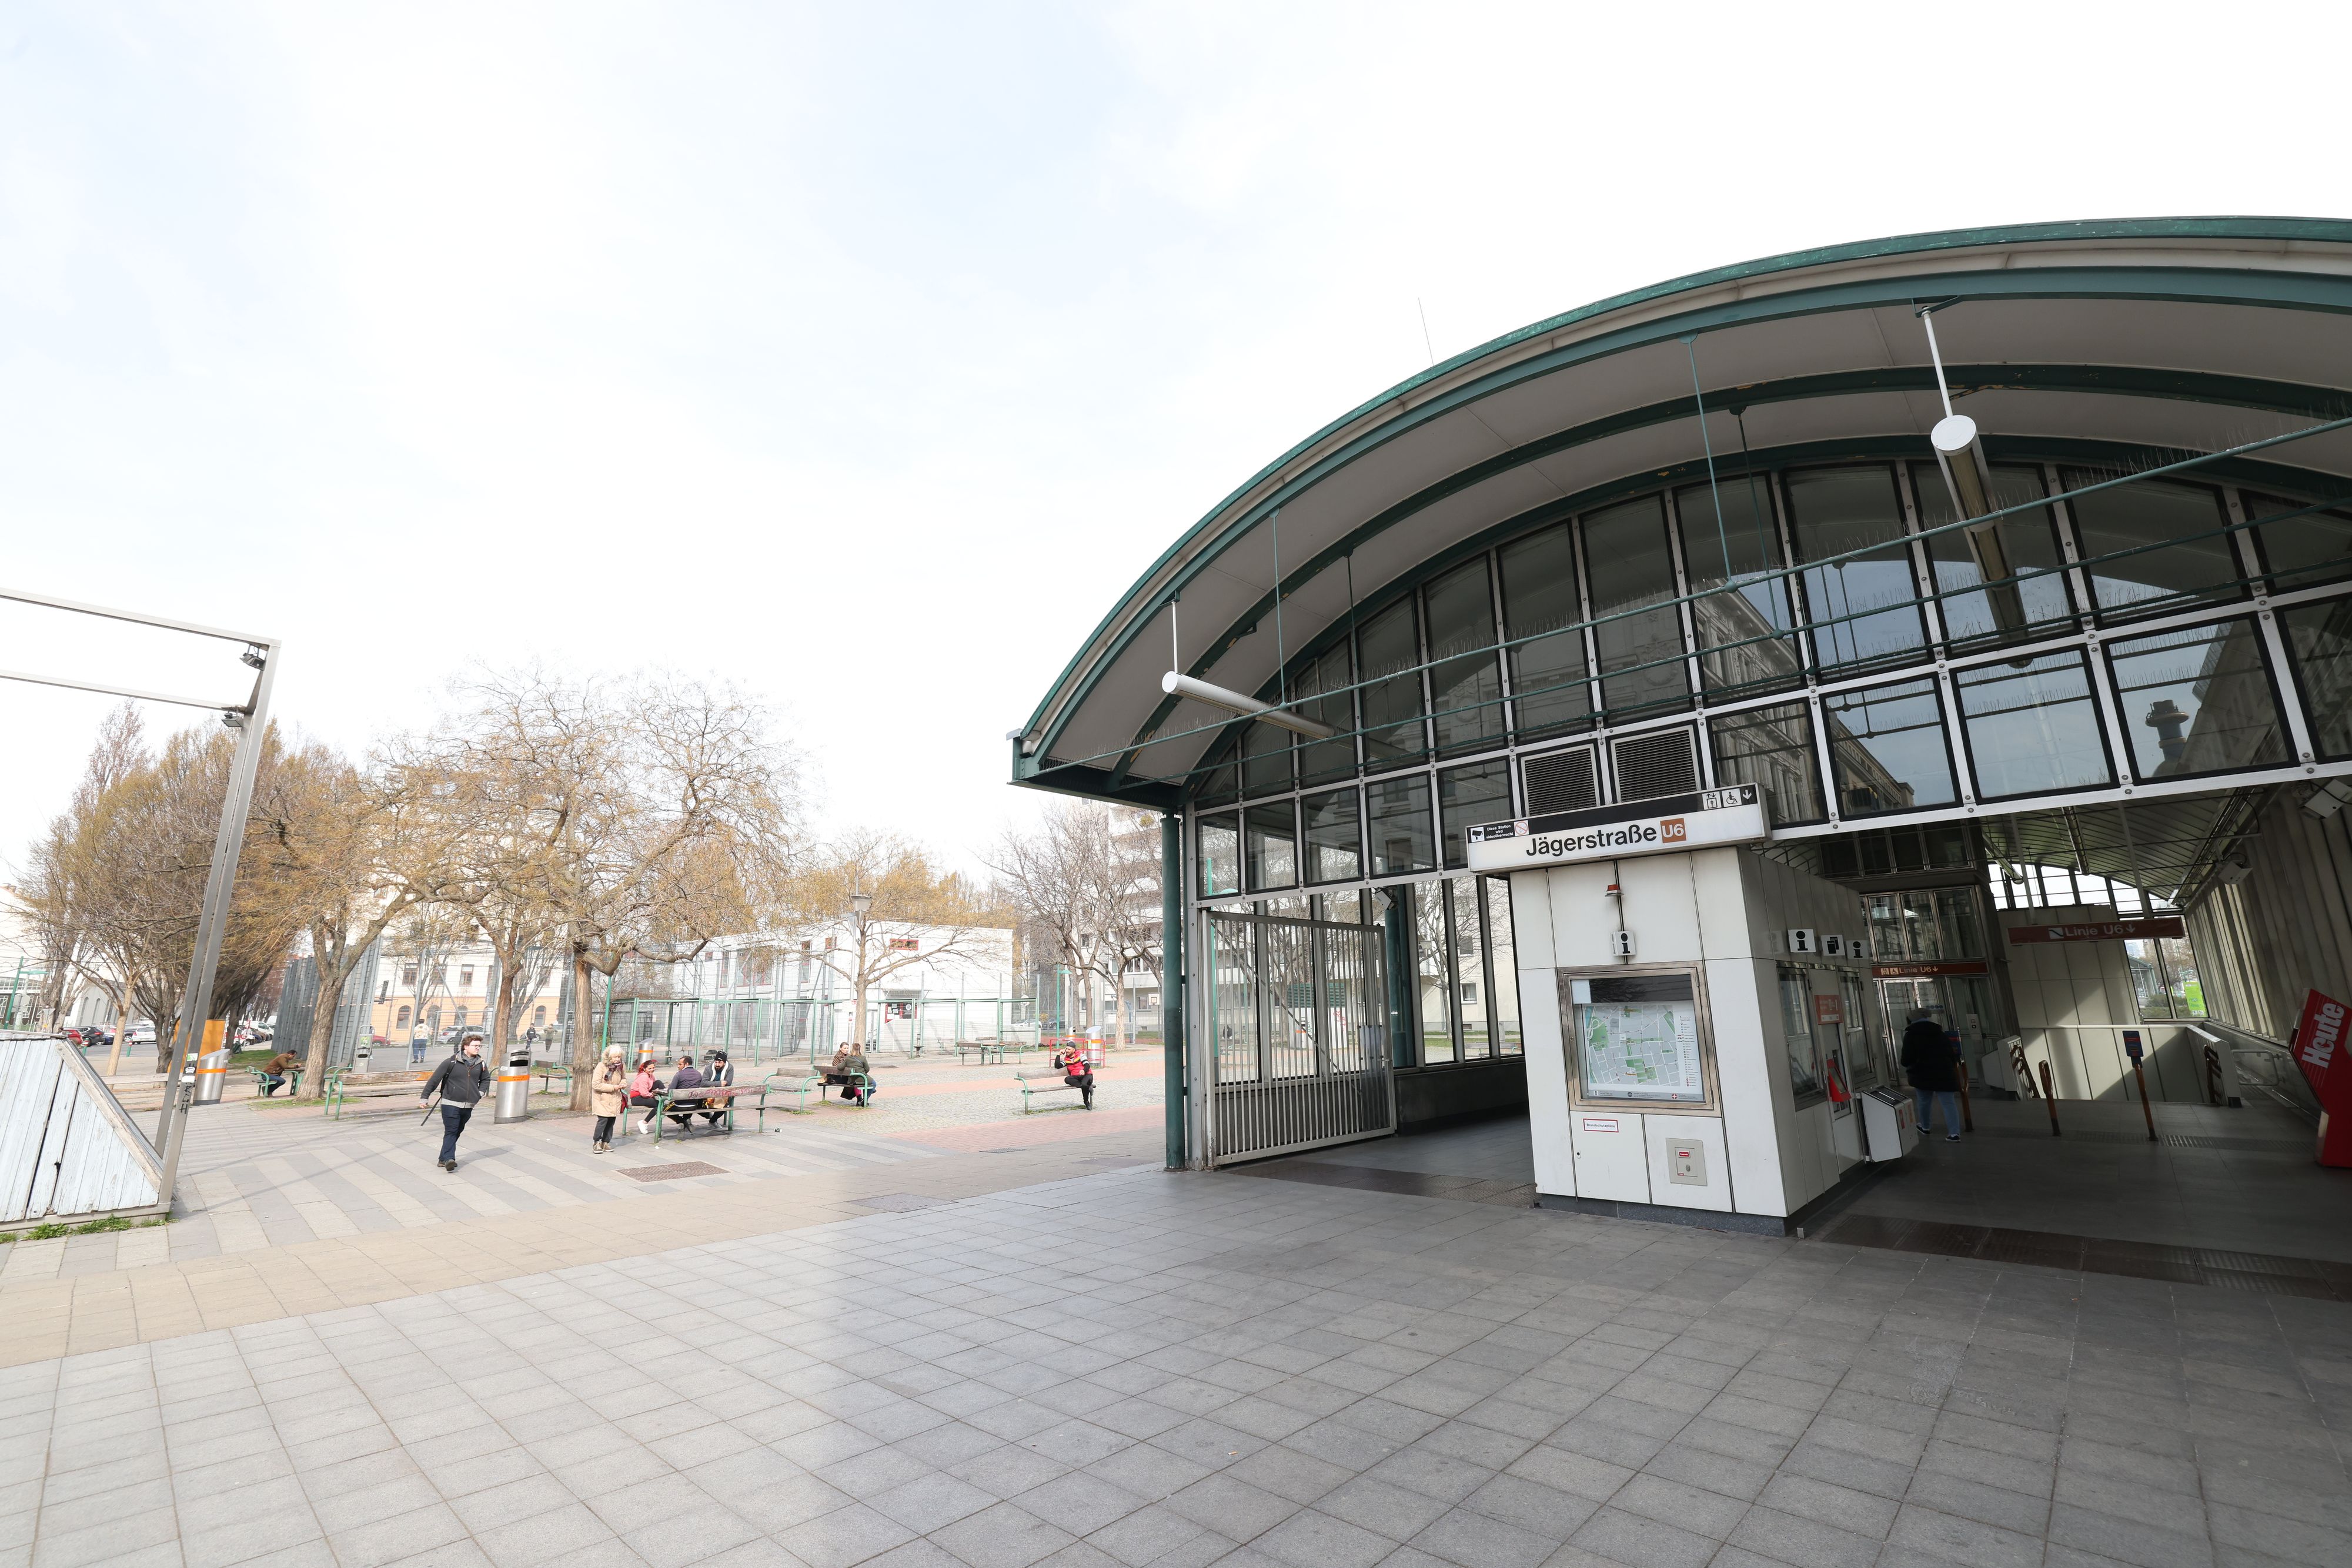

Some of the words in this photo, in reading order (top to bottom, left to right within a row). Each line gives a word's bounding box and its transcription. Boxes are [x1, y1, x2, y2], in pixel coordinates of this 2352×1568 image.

[1526, 824, 1657, 857] Jägerstraße
[1662, 823, 1684, 838] U6
[2065, 927, 2098, 937] Linie
[2103, 925, 2124, 935] U6
[2301, 1003, 2345, 1068] Heute
